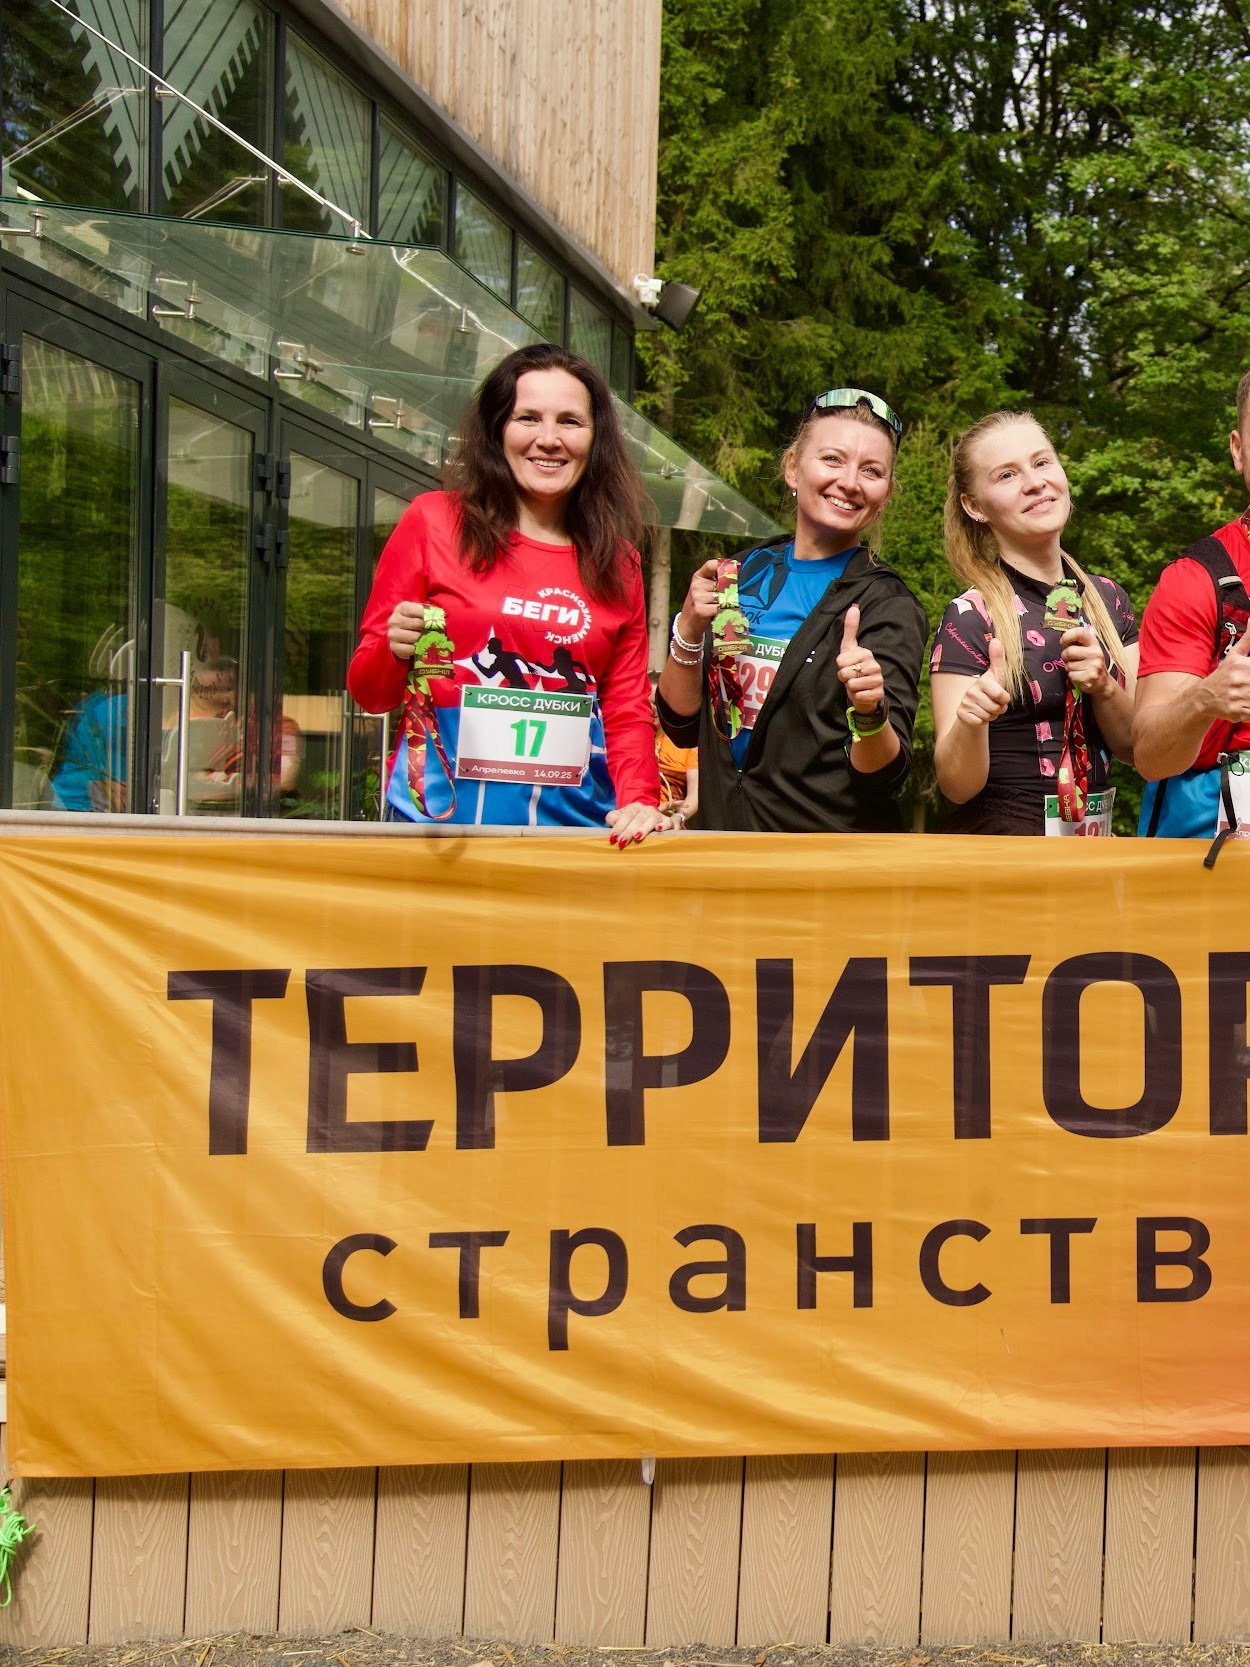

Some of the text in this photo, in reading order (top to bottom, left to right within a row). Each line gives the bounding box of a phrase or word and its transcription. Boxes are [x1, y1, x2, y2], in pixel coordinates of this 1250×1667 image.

[502, 596, 580, 626] БЕГИ
[537, 587, 592, 645] КРАСНОЗНАМЕНСК
[755, 643, 785, 658] ДУБ
[737, 661, 777, 705] 29
[477, 693, 581, 713] КРОСС ДУБКИ
[510, 719, 548, 758] 17
[472, 764, 573, 779] Апрелевка 14.09.25
